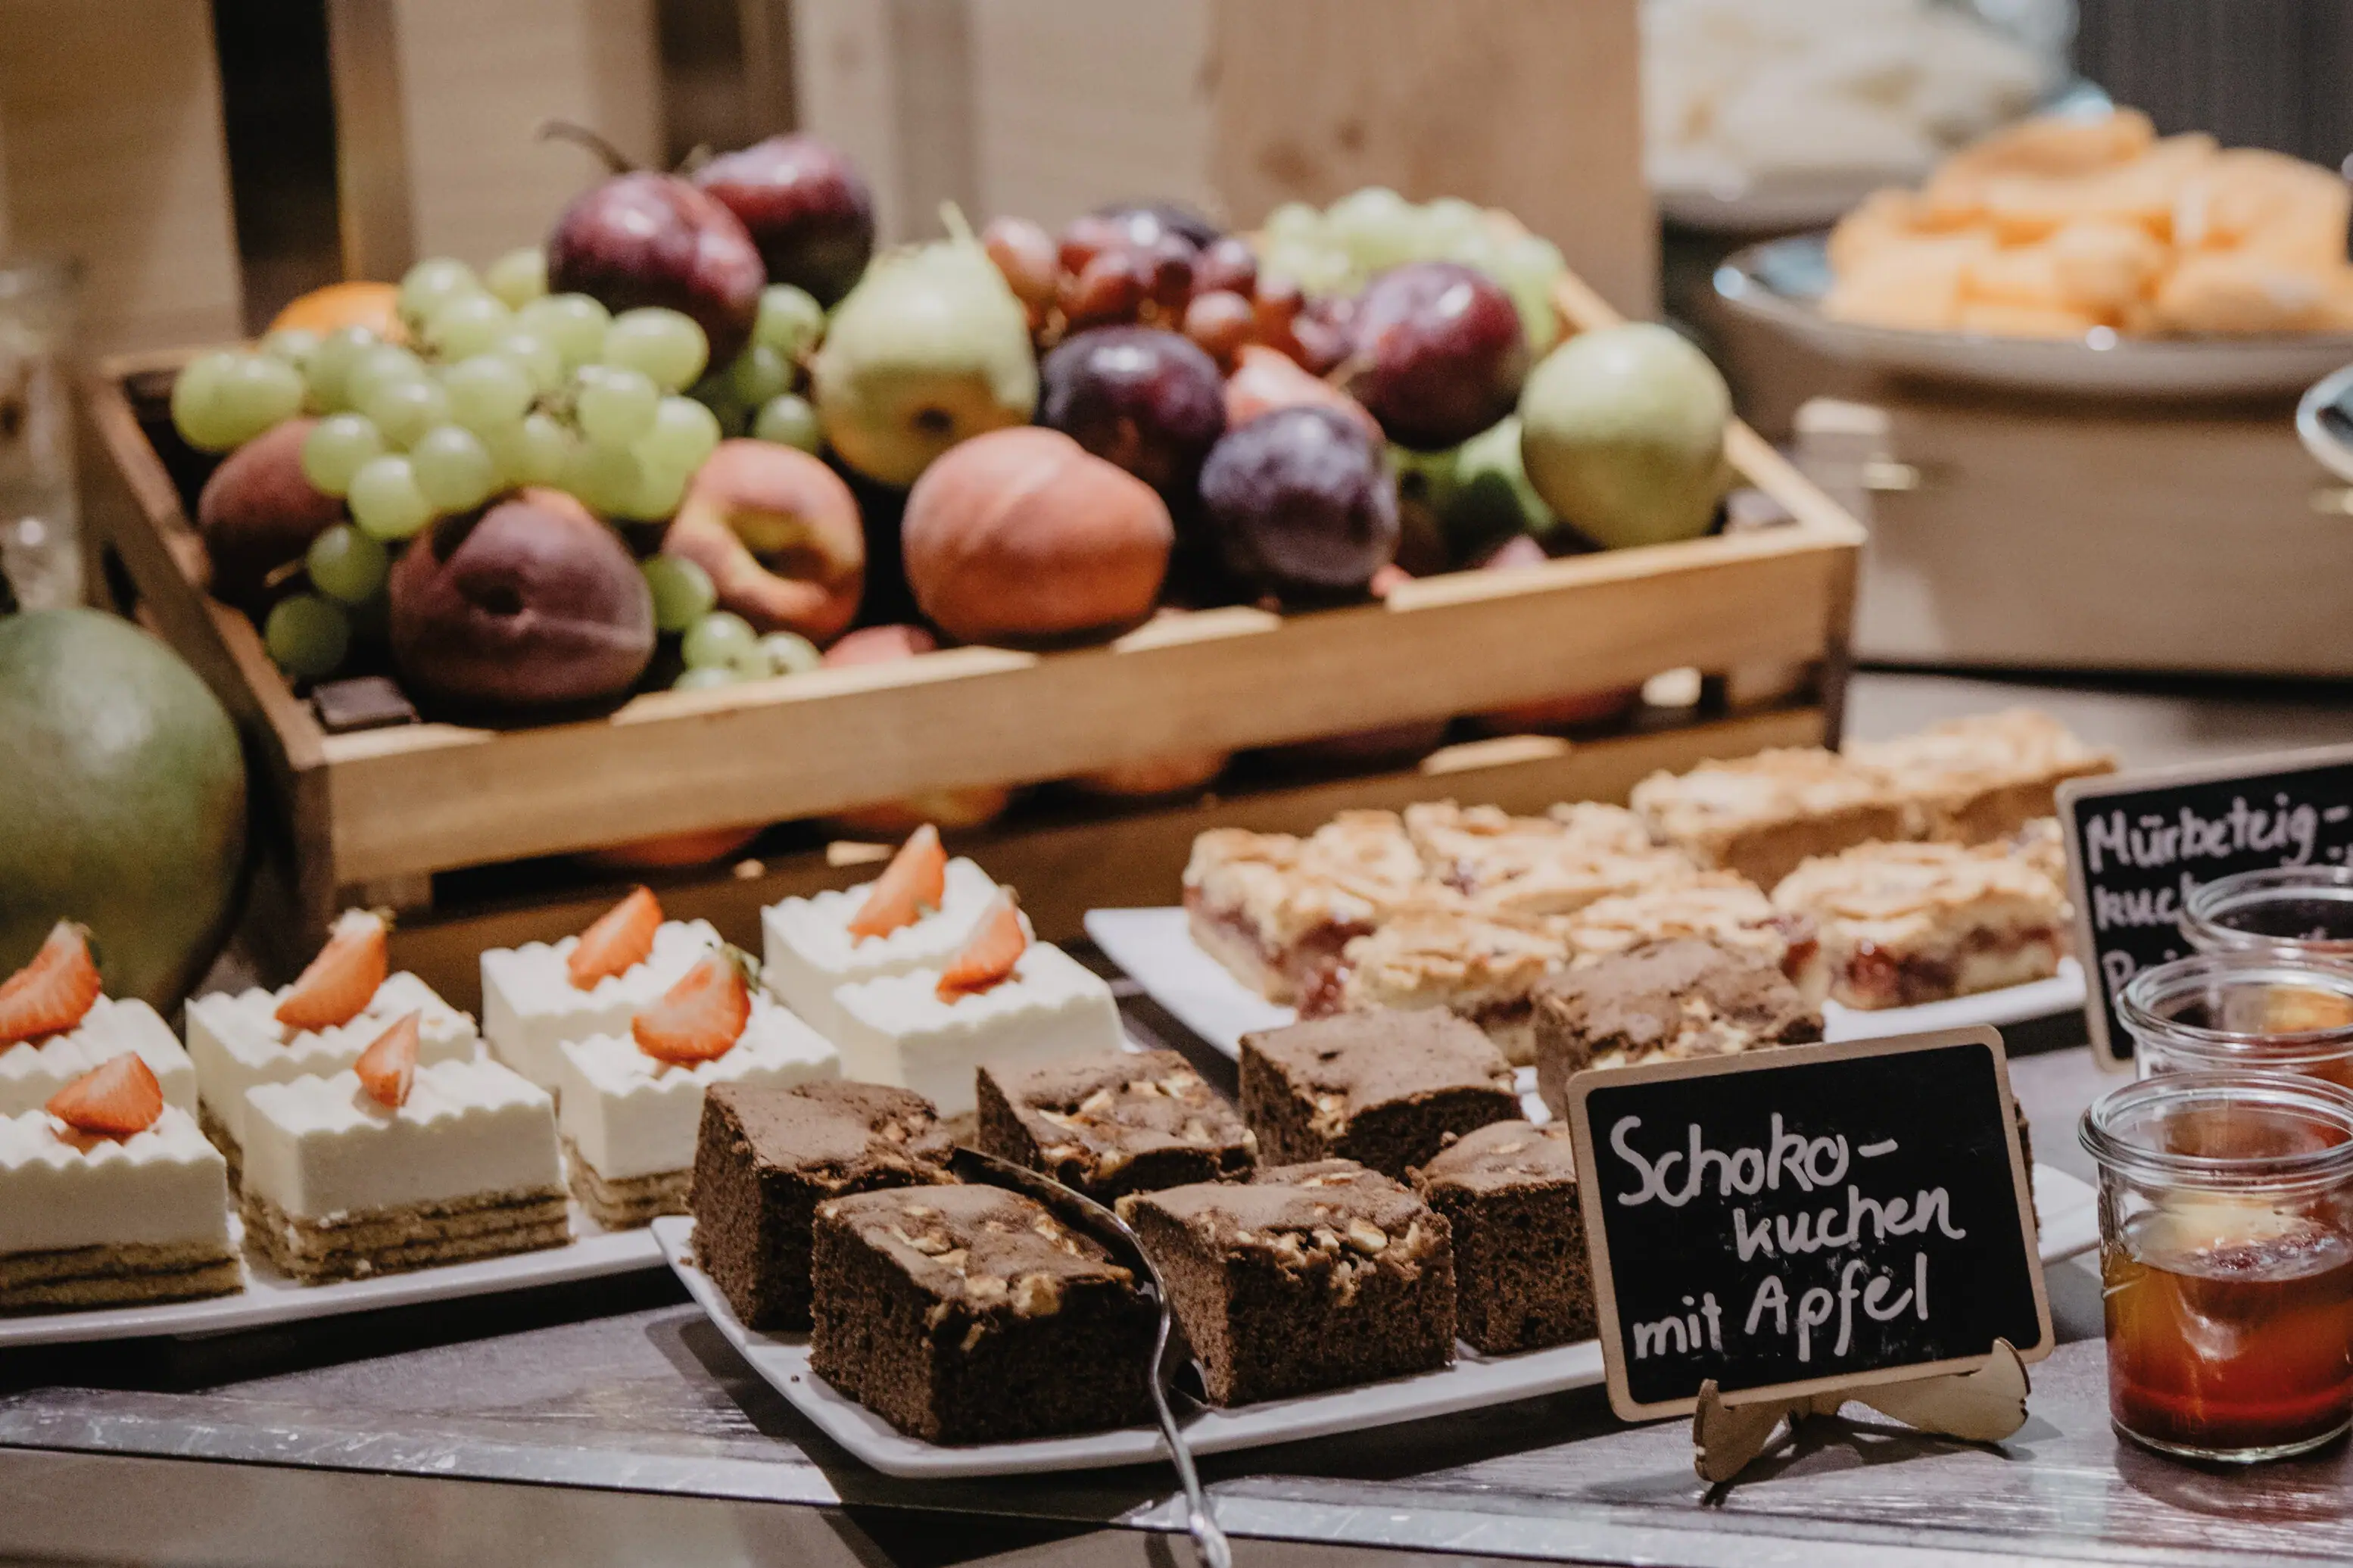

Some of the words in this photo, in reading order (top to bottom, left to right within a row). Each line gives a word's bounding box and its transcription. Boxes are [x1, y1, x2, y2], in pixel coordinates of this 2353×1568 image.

[1610, 1112, 1899, 1207] Schoko-
[1734, 1185, 1966, 1261] kuchen
[1633, 1291, 1722, 1359] mit
[1744, 1252, 1928, 1362] Apfel
